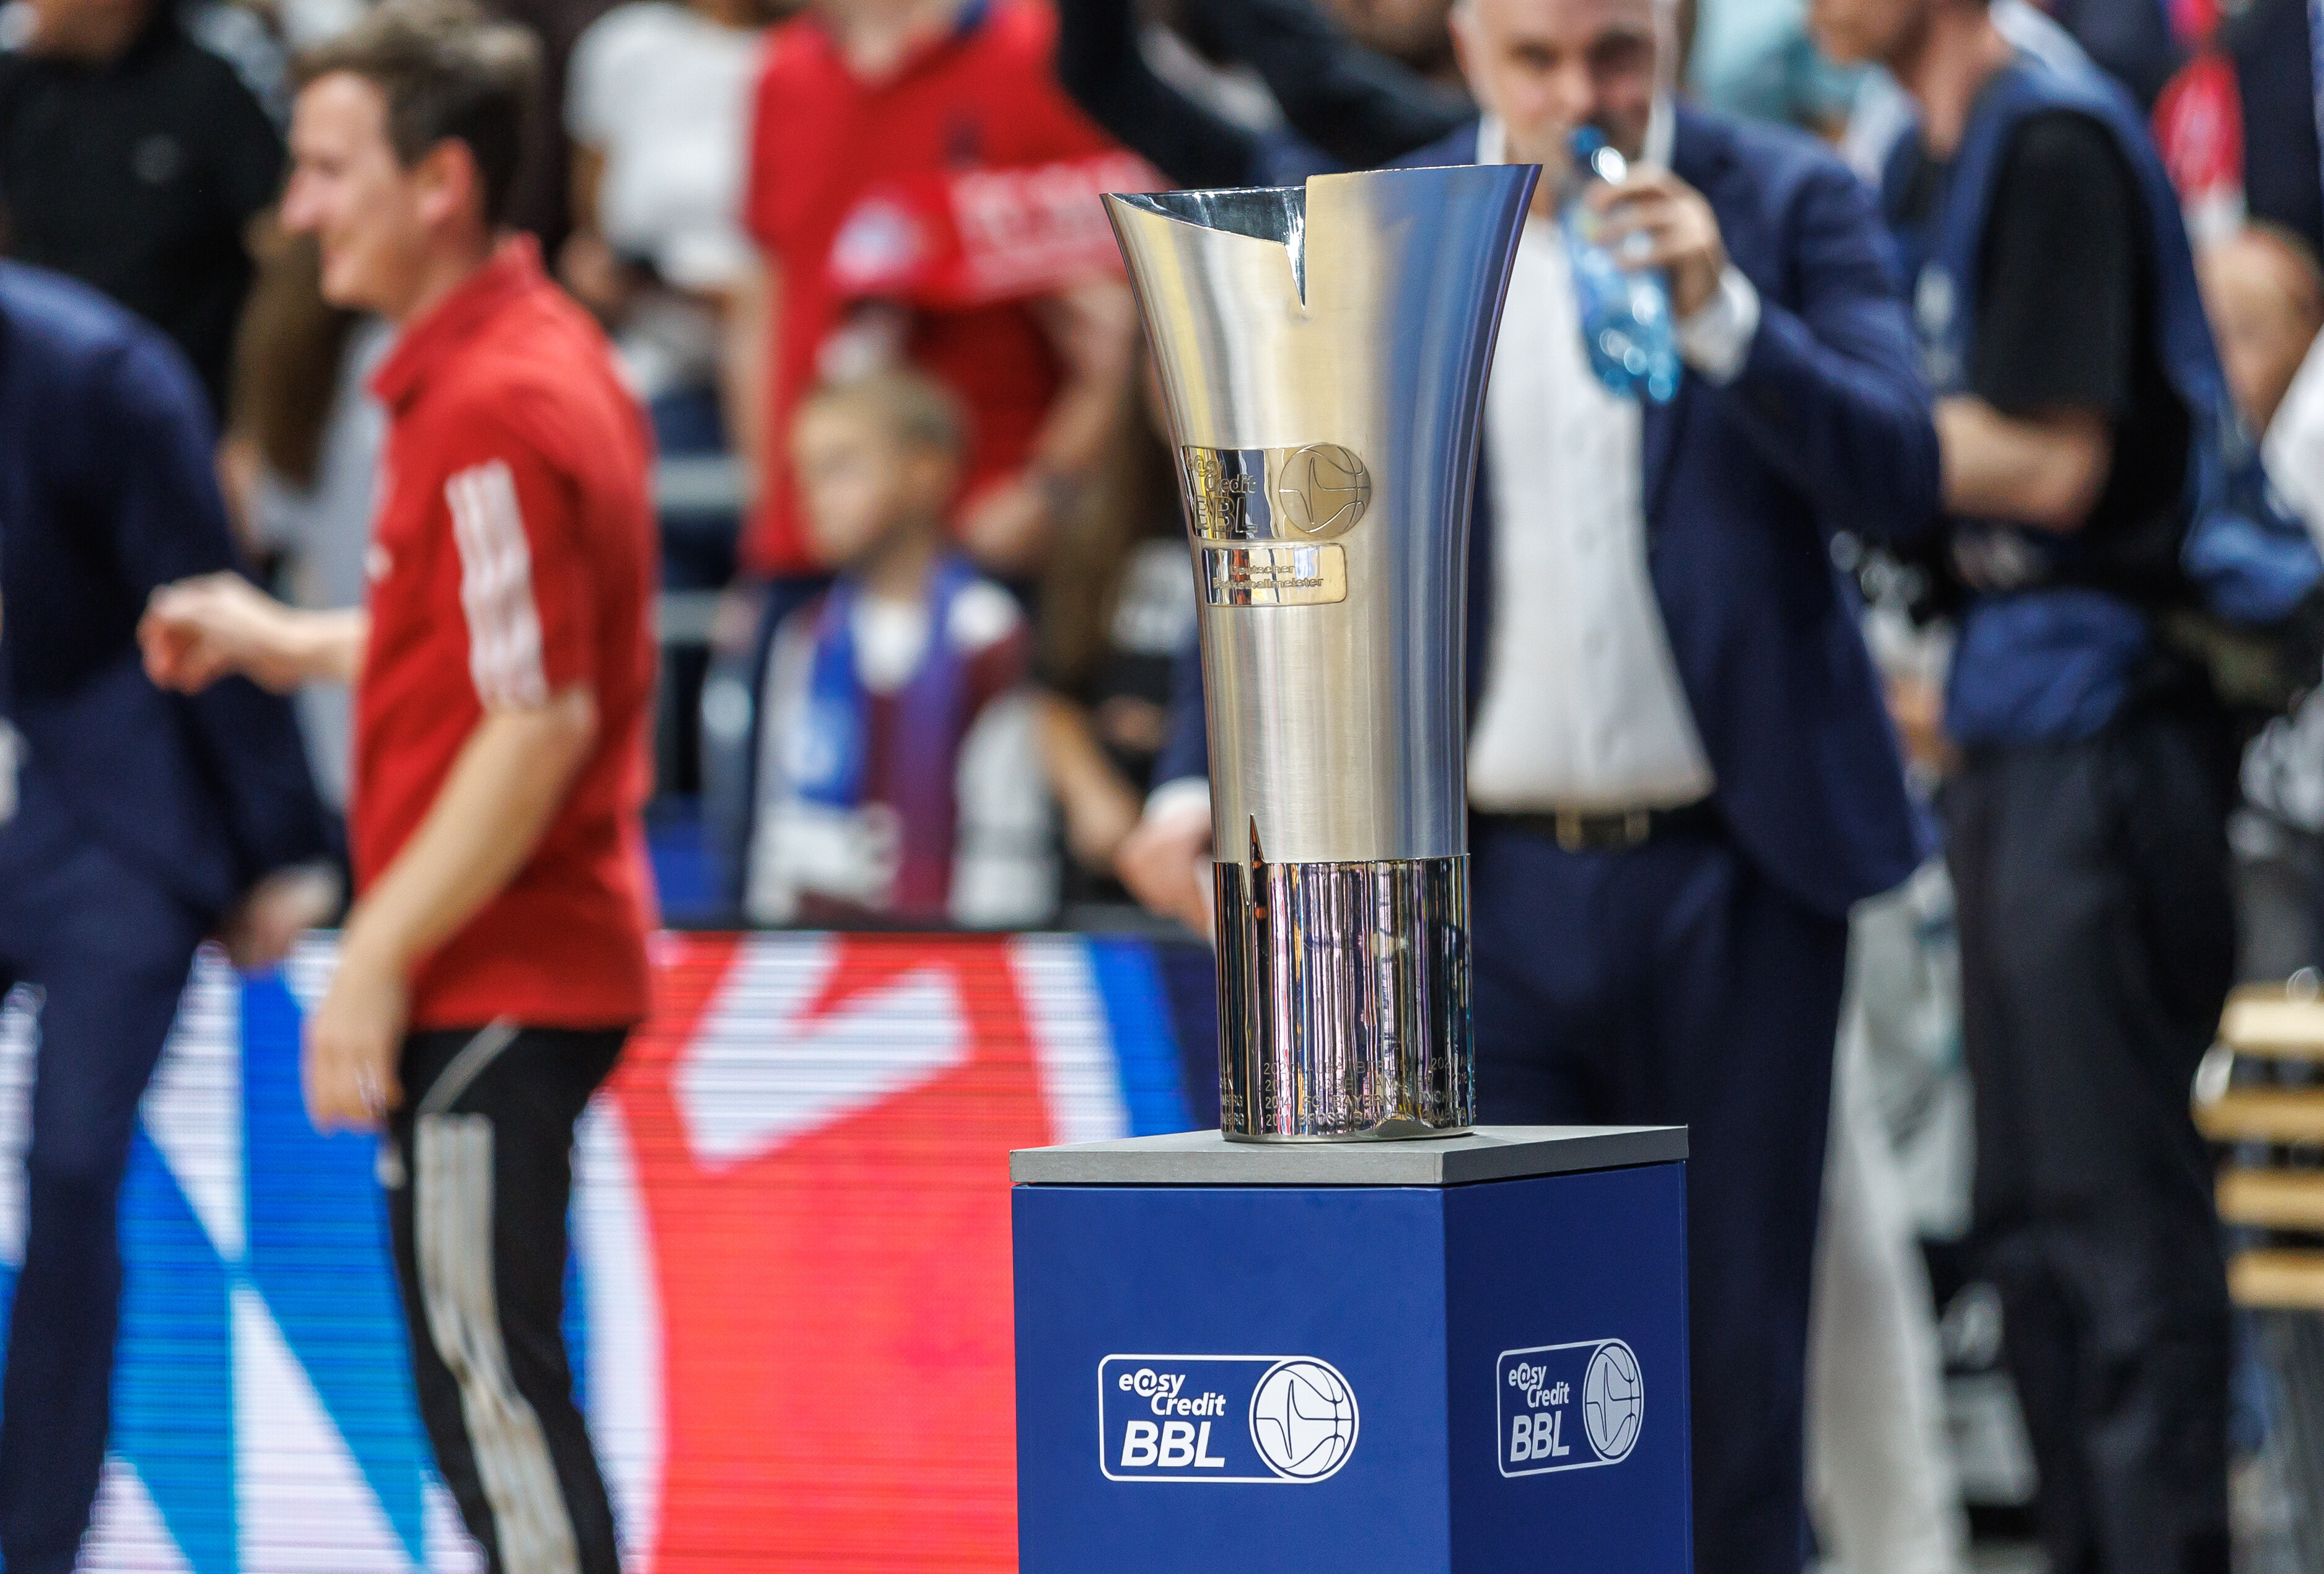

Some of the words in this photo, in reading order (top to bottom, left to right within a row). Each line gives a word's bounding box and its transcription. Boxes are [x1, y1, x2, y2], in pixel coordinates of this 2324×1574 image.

[1194, 495, 1258, 533] BBL
[1212, 577, 1324, 589] Basketballmeister
[1230, 565, 1296, 575] Deutscher
[1265, 1096, 1292, 1109] 2014
[1151, 1392, 1226, 1417] Credit
[1527, 1381, 1569, 1408] Credit
[1120, 1420, 1225, 1467] BBL
[1510, 1410, 1570, 1462] BBL
